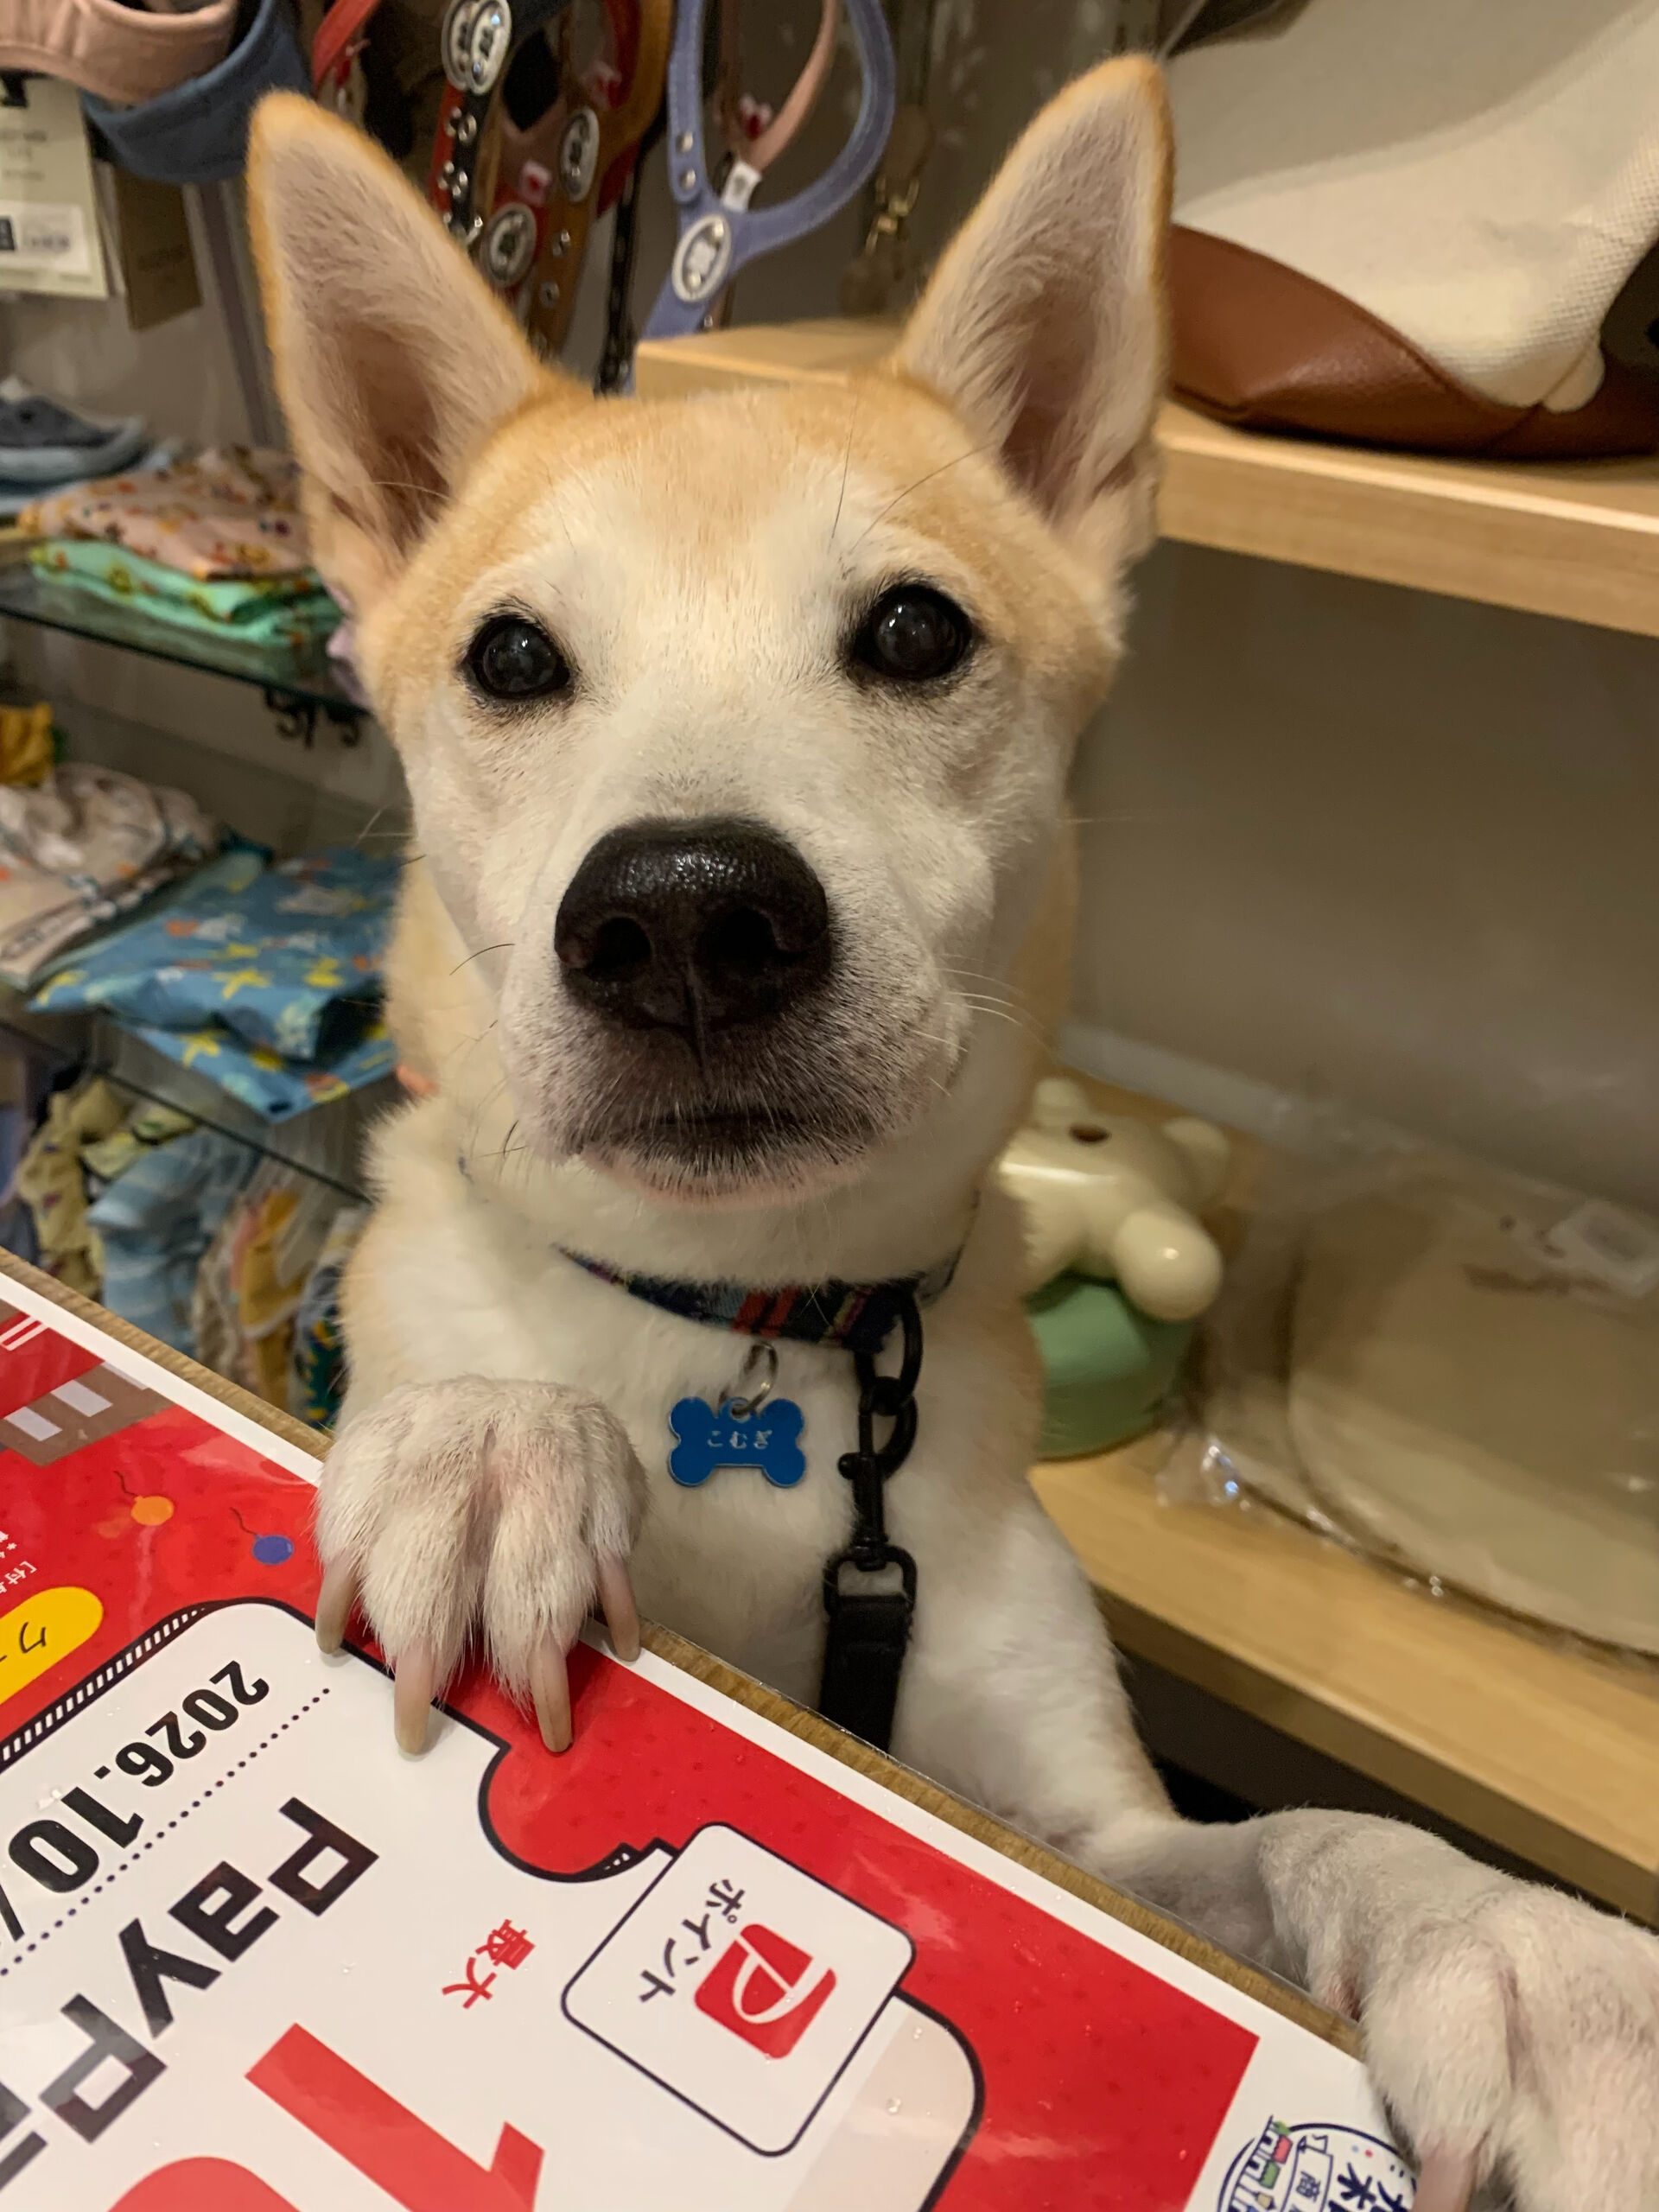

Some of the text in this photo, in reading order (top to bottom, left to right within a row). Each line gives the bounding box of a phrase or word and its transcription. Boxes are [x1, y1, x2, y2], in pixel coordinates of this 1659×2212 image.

[707, 1430, 773, 1450] こむぎ
[442, 1919, 536, 2009] 最大
[639, 1878, 746, 2003] ポイント
